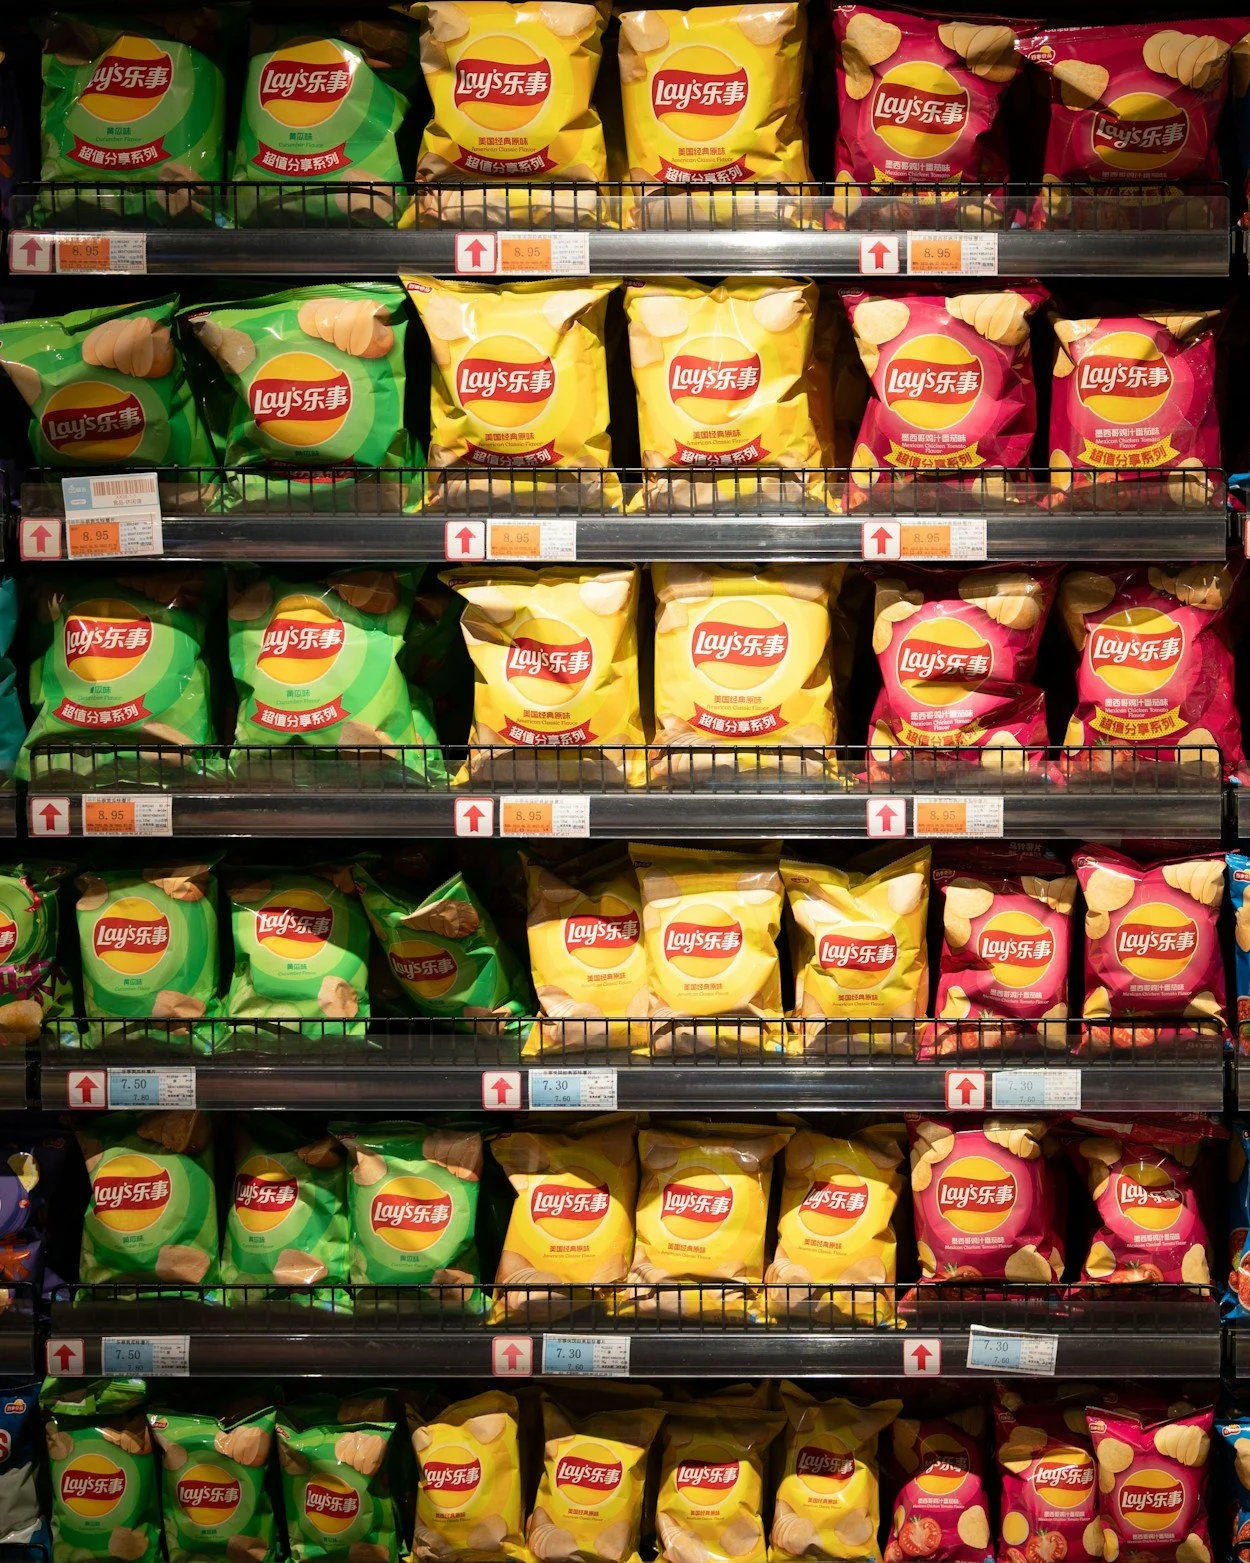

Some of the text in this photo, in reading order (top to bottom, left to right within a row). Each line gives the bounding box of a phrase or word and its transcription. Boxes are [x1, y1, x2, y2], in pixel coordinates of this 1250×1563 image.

[78, 146, 158, 166] 超值分享系列
[262, 151, 340, 172] 超值分享系列
[465, 155, 545, 177] 超值分享系列
[72, 245, 99, 256] 8.95
[514, 246, 541, 257] 8.95
[924, 247, 951, 259] 8.95
[680, 446, 759, 466] 超值分享系列
[83, 530, 109, 541] 8.95
[503, 533, 529, 544] 8.95
[914, 532, 940, 543] 8.95
[62, 703, 138, 723] 超值分享系列
[261, 706, 337, 728] 超值分享系列
[698, 713, 776, 734] 超值分享系列
[1099, 715, 1174, 735] 超值分享系列
[98, 809, 124, 820] 8.95
[516, 811, 542, 822] 8.95
[930, 810, 955, 821] 8.95
[122, 1079, 147, 1089] 7.50
[542, 1080, 568, 1090] 7.30
[1008, 1080, 1033, 1091] 7.30
[984, 1340, 1009, 1351] 7.30
[116, 1349, 141, 1359] 7.50
[556, 1348, 581, 1359] 7.30
